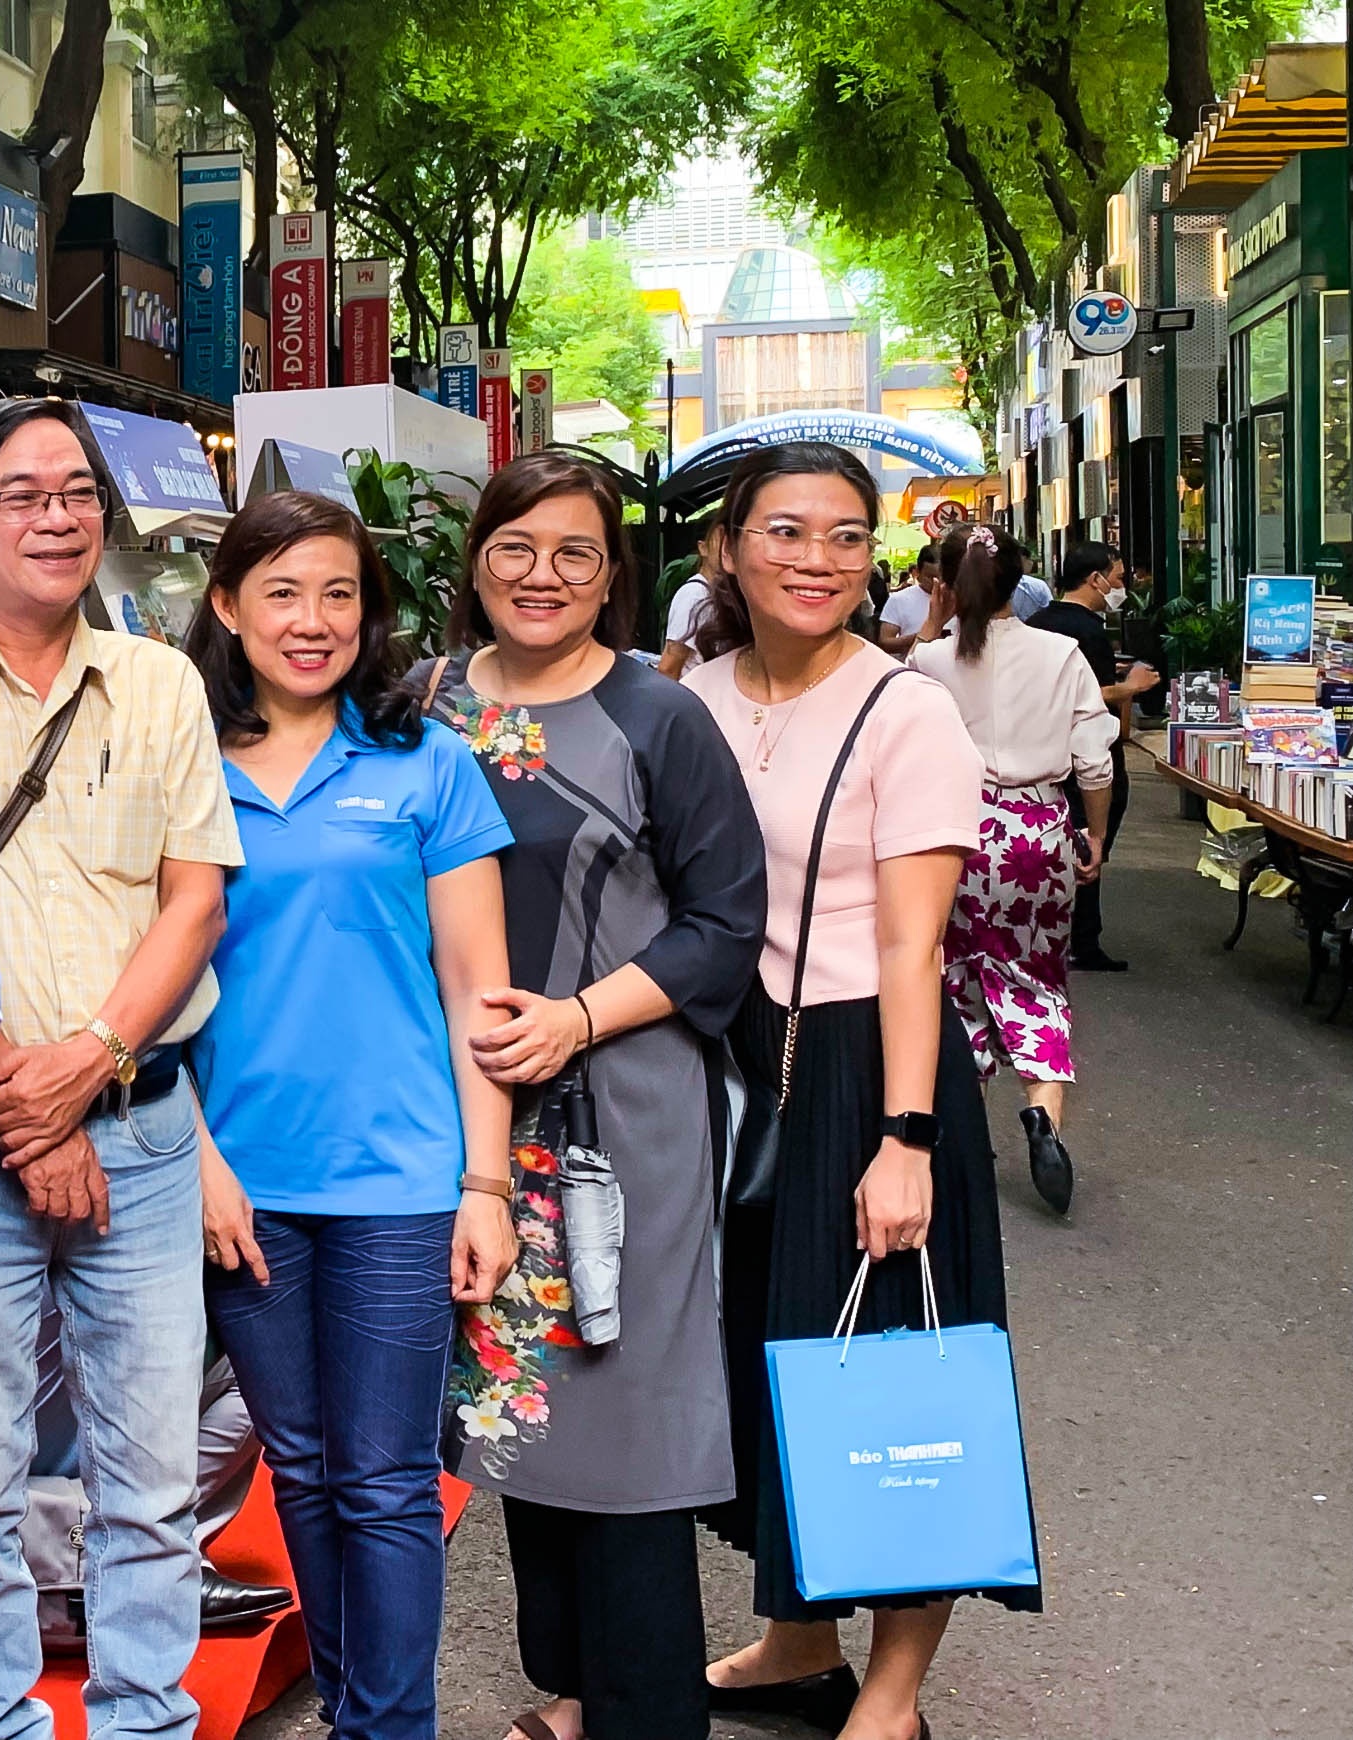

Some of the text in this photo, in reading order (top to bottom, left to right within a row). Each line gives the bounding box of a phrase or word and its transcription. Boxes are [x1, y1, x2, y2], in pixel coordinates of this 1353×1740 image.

[281, 265, 302, 285] A
[307, 264, 316, 308] COMPANY
[278, 293, 303, 375] ĐÔNG
[849, 1449, 883, 1465] Báo
